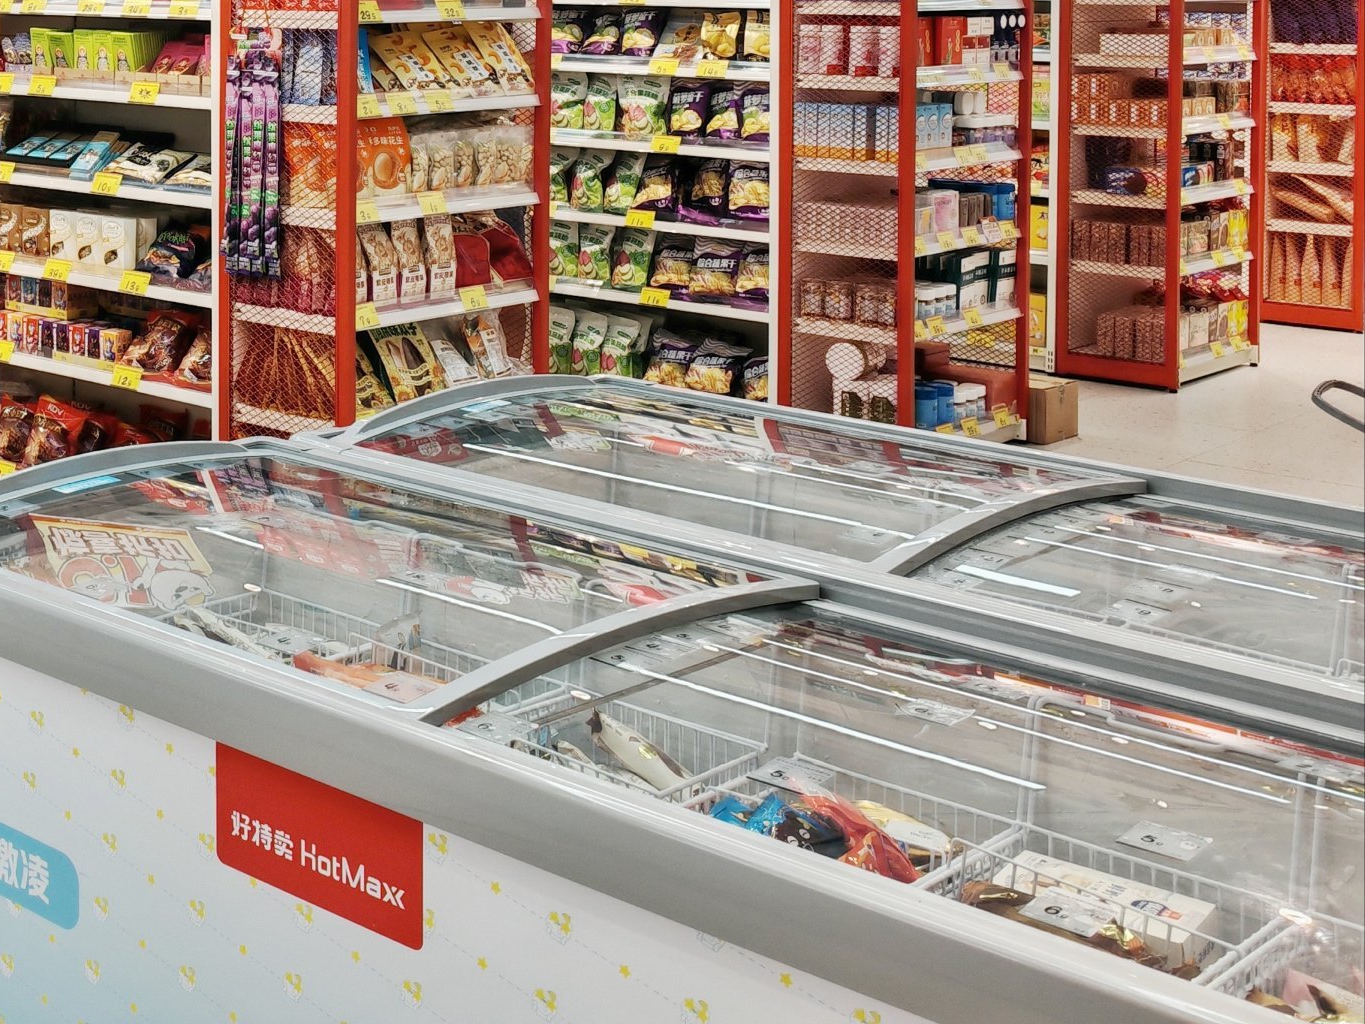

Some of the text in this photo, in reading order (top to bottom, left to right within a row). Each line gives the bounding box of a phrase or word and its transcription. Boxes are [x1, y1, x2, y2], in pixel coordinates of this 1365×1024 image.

[231, 810, 406, 910] 好特卖 HotMaxx
